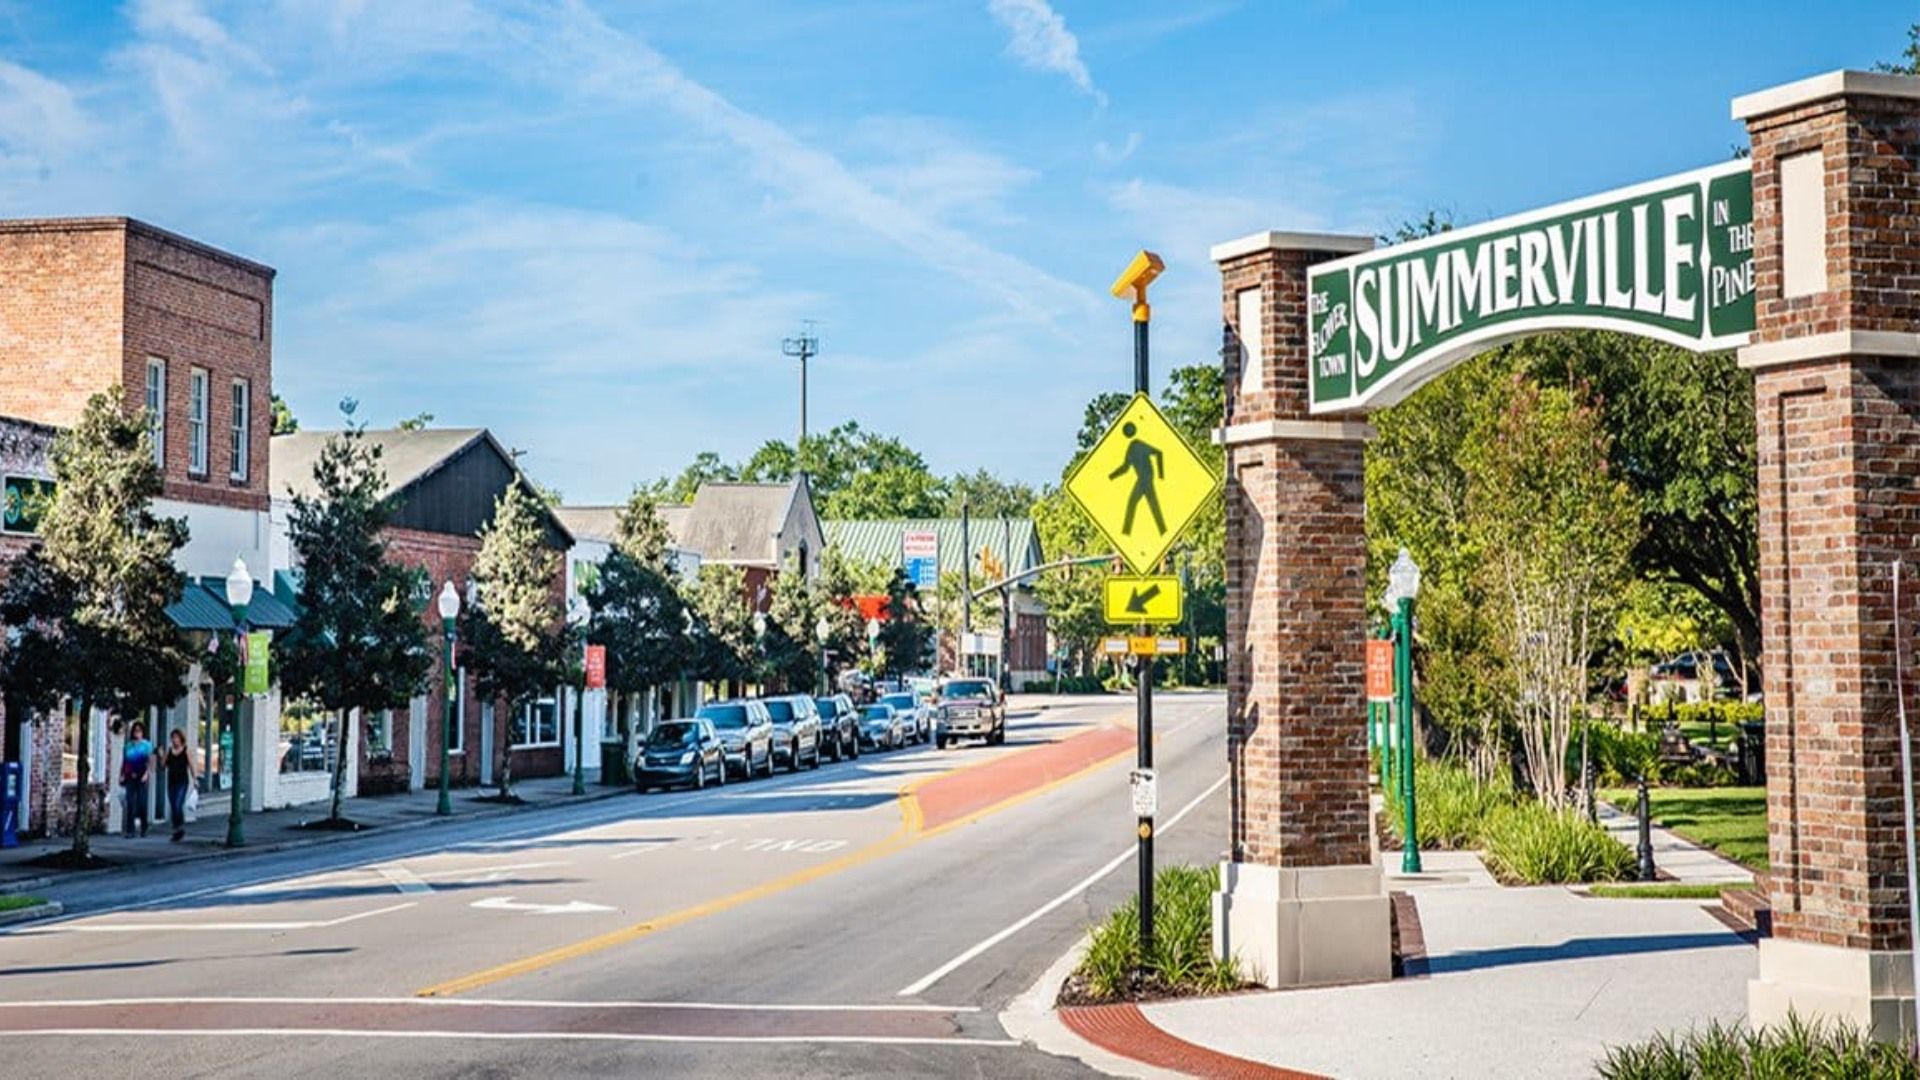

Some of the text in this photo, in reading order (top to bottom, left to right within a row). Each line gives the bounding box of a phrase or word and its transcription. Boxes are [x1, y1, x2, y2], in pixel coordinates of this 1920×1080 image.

[1713, 199, 1729, 226] IN
[1727, 222, 1754, 253] THE
[1355, 193, 1696, 378] SUMMERVILLE
[1311, 291, 1329, 313] THE
[1312, 303, 1348, 355] FLOWER
[1318, 353, 1346, 377] TOWN
